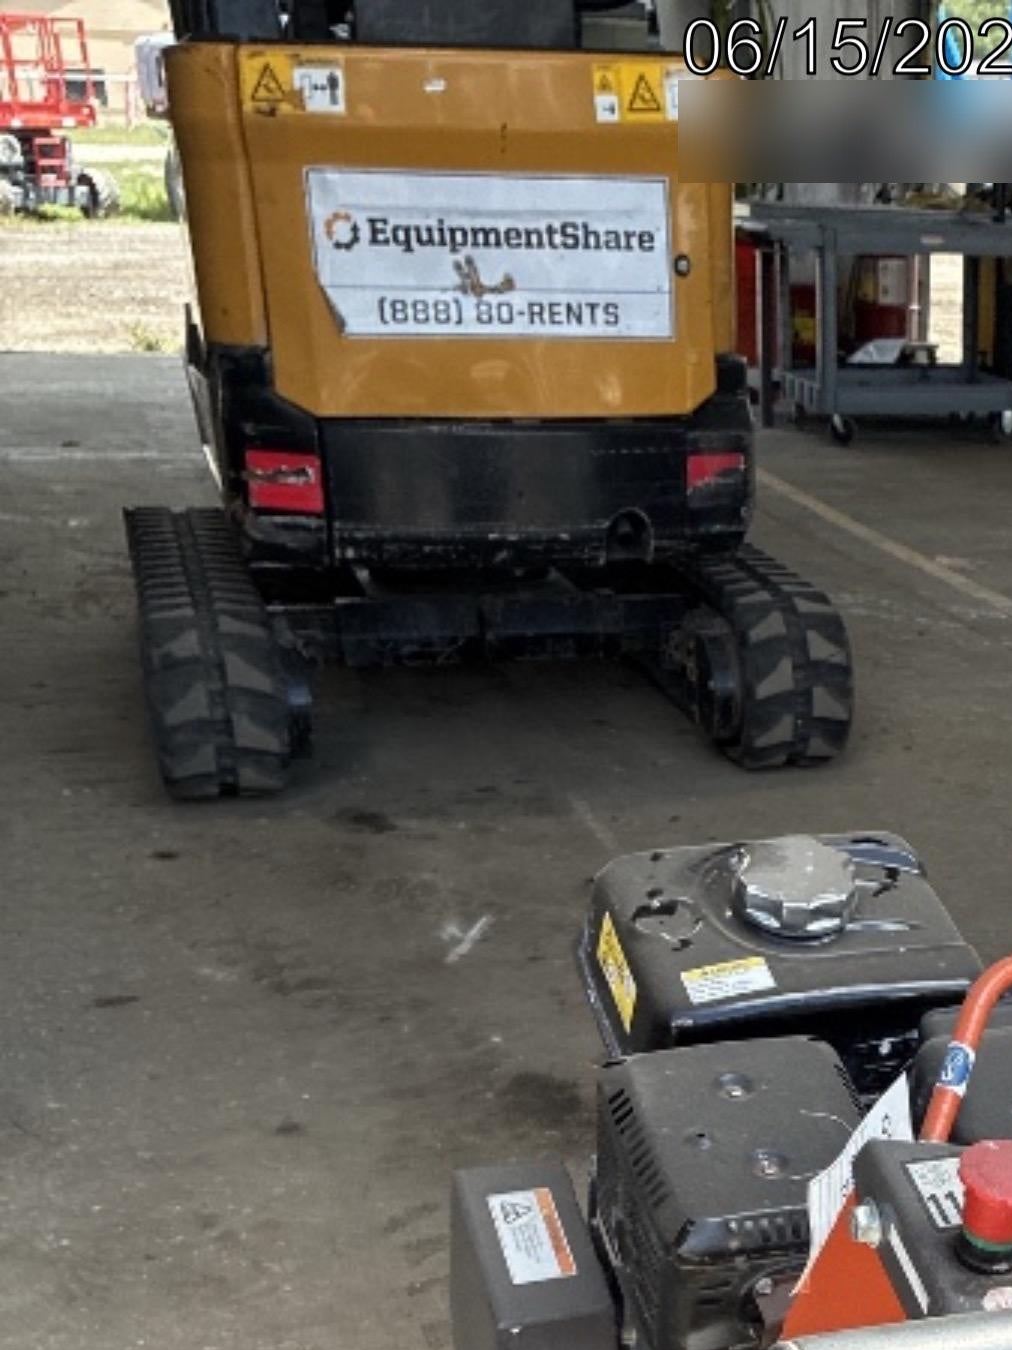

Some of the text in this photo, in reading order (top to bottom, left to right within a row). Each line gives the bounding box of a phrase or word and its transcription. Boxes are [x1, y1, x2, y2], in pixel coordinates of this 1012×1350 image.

[366, 217, 656, 252] EquipmentShare
[379, 298, 621, 327] (888) 80-RENTS
